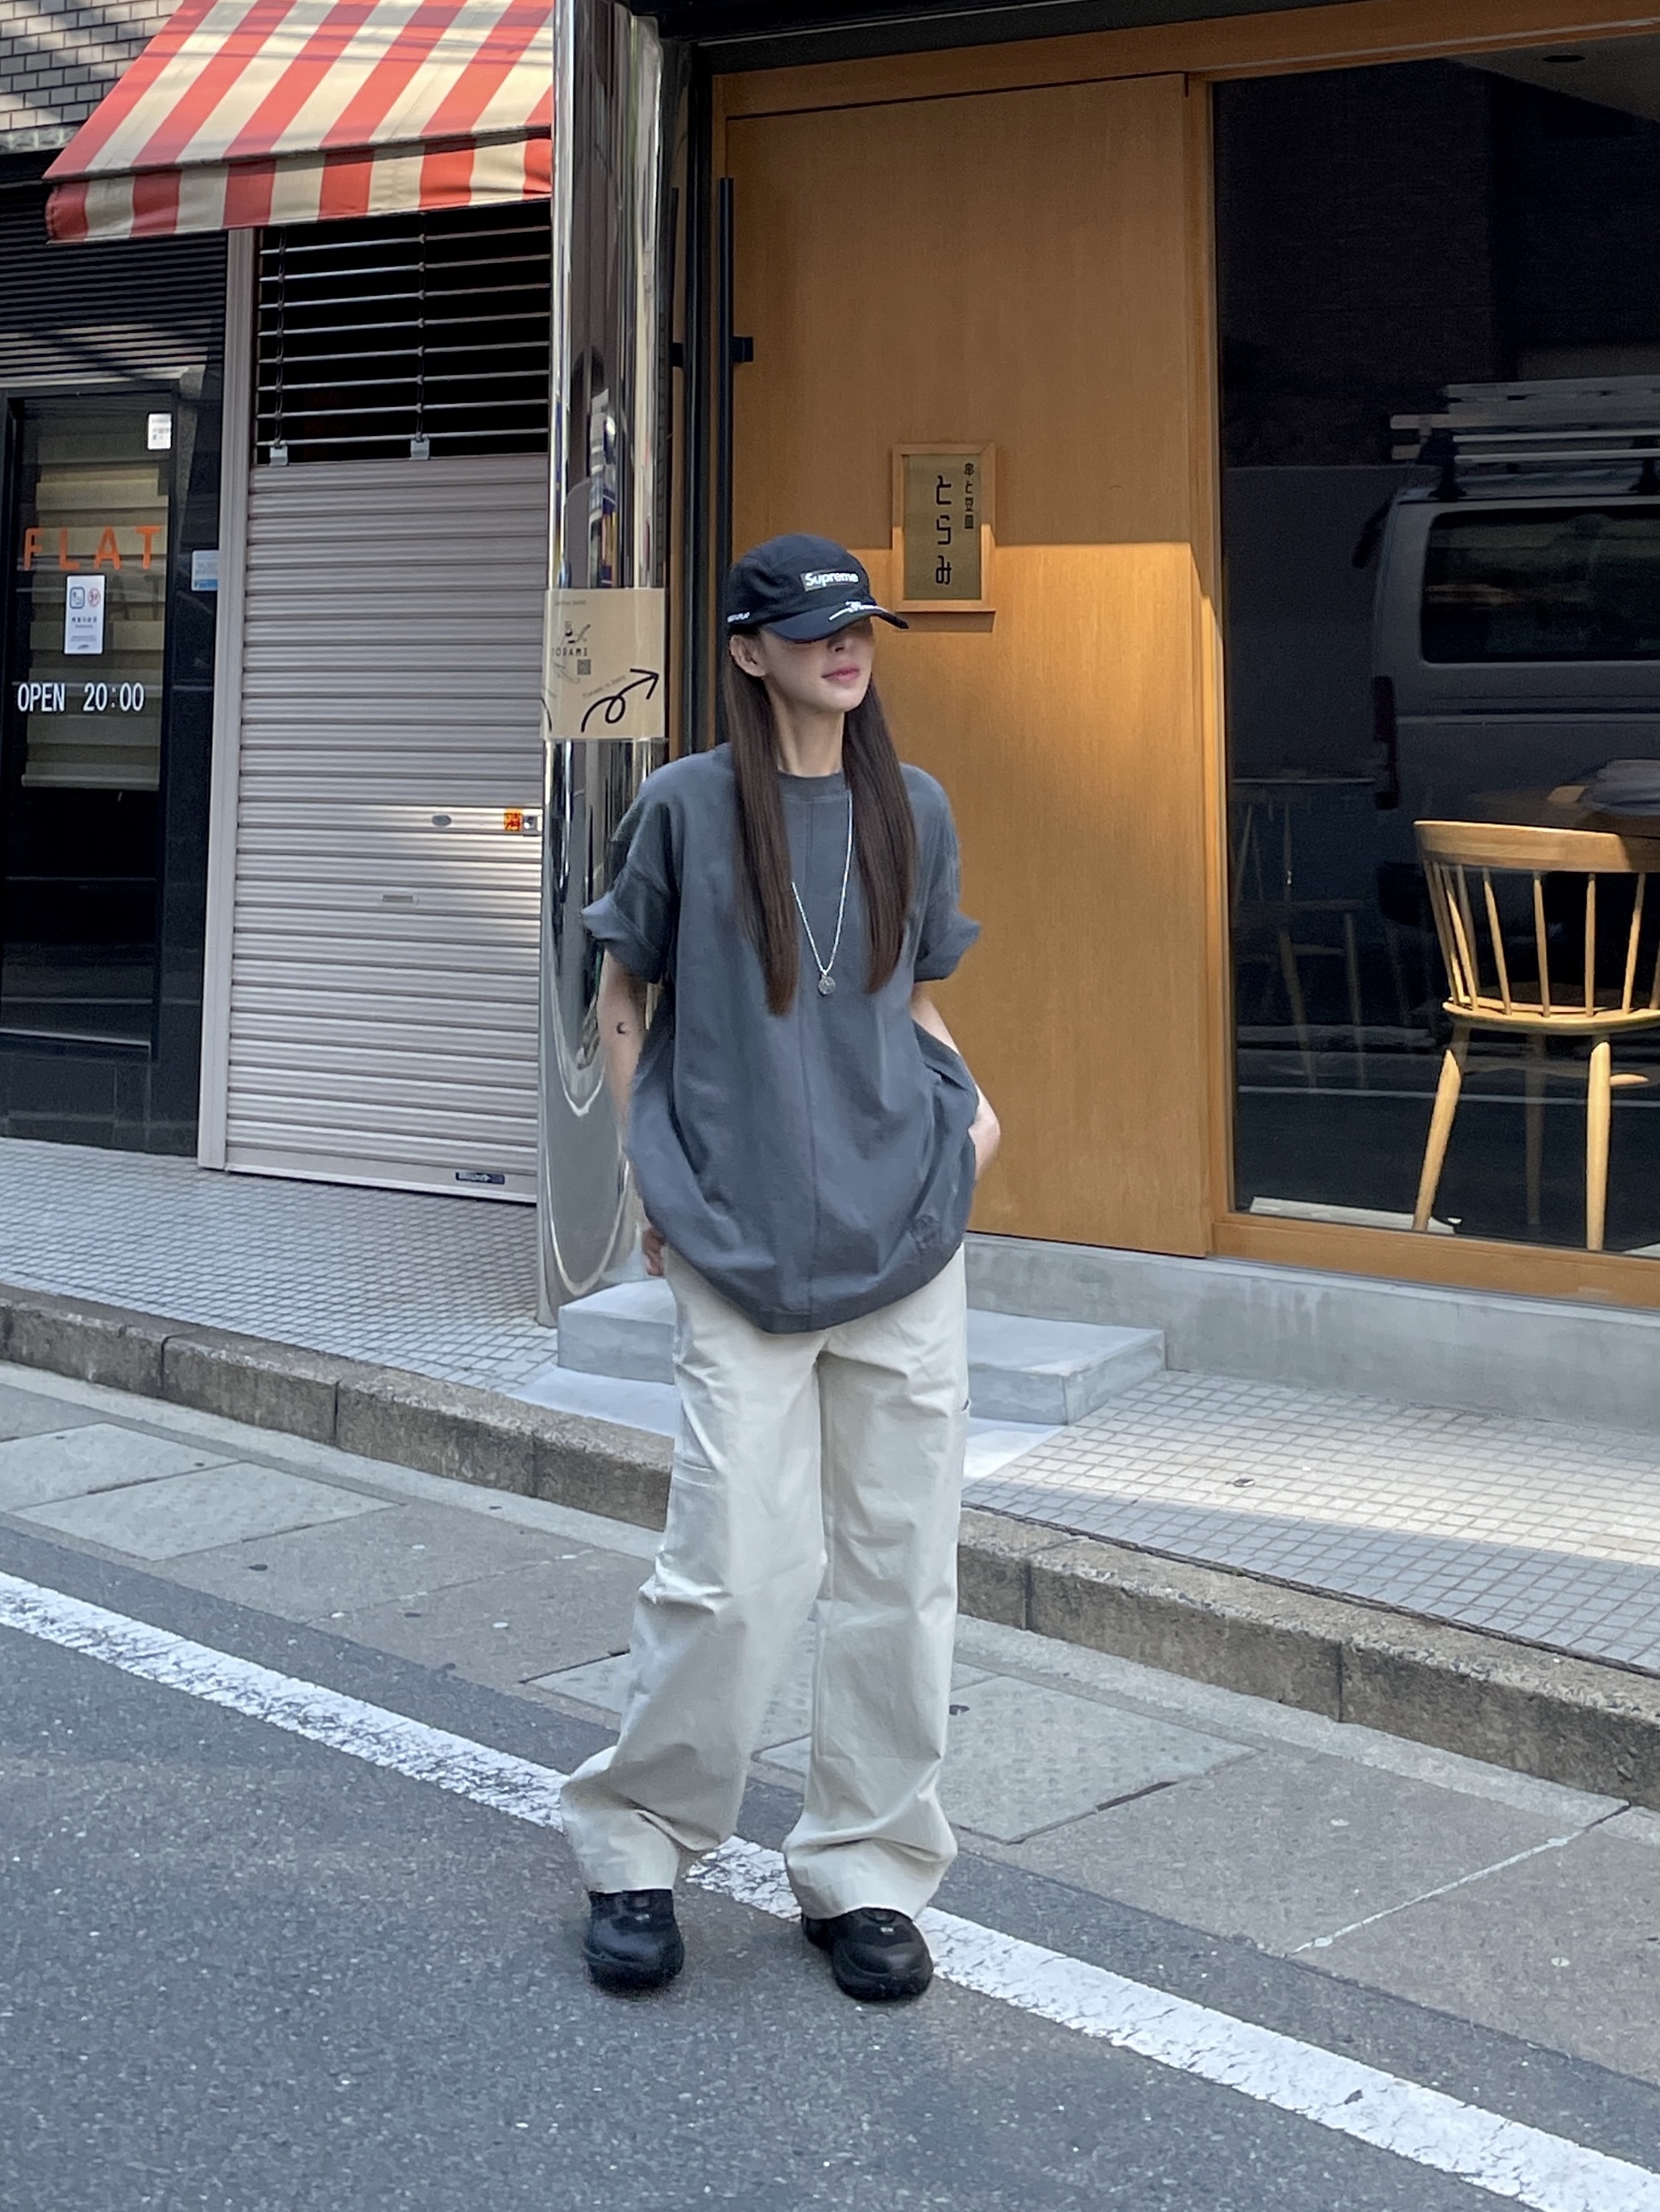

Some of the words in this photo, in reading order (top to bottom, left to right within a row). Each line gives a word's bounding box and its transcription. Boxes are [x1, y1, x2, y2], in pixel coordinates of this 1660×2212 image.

[23, 525, 160, 571] FLAT
[936, 475, 952, 584] とらみ
[805, 572, 859, 587] Supreme
[18, 683, 65, 712] OPEN
[83, 683, 144, 712] 20:00
